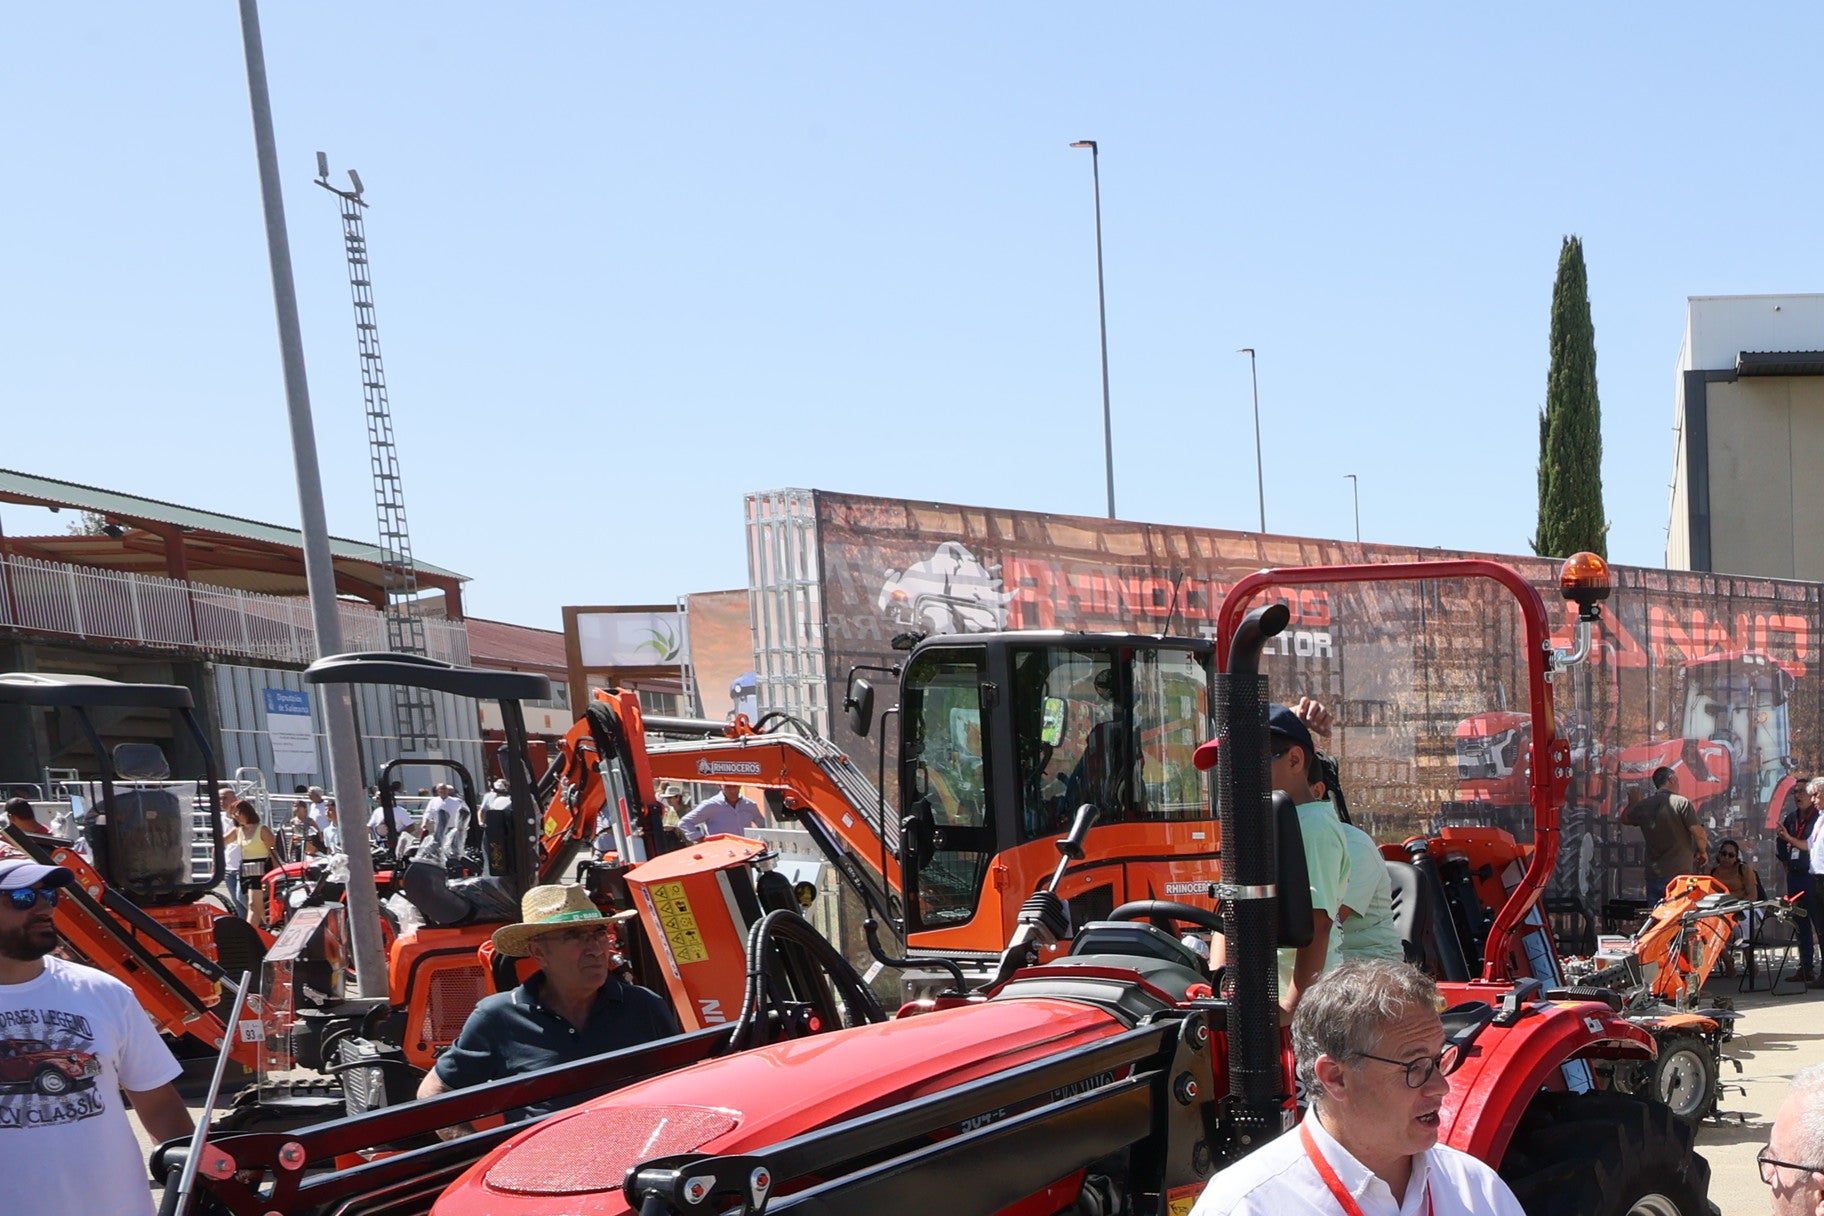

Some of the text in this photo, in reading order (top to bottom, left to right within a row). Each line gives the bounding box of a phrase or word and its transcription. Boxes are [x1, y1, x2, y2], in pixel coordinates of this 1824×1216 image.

[713, 762, 760, 773] RHINOCEROS
[1166, 882, 1209, 894] RHINOCER
[39, 1008, 95, 1037] LEGEND
[26, 1088, 105, 1124] CLASSIC
